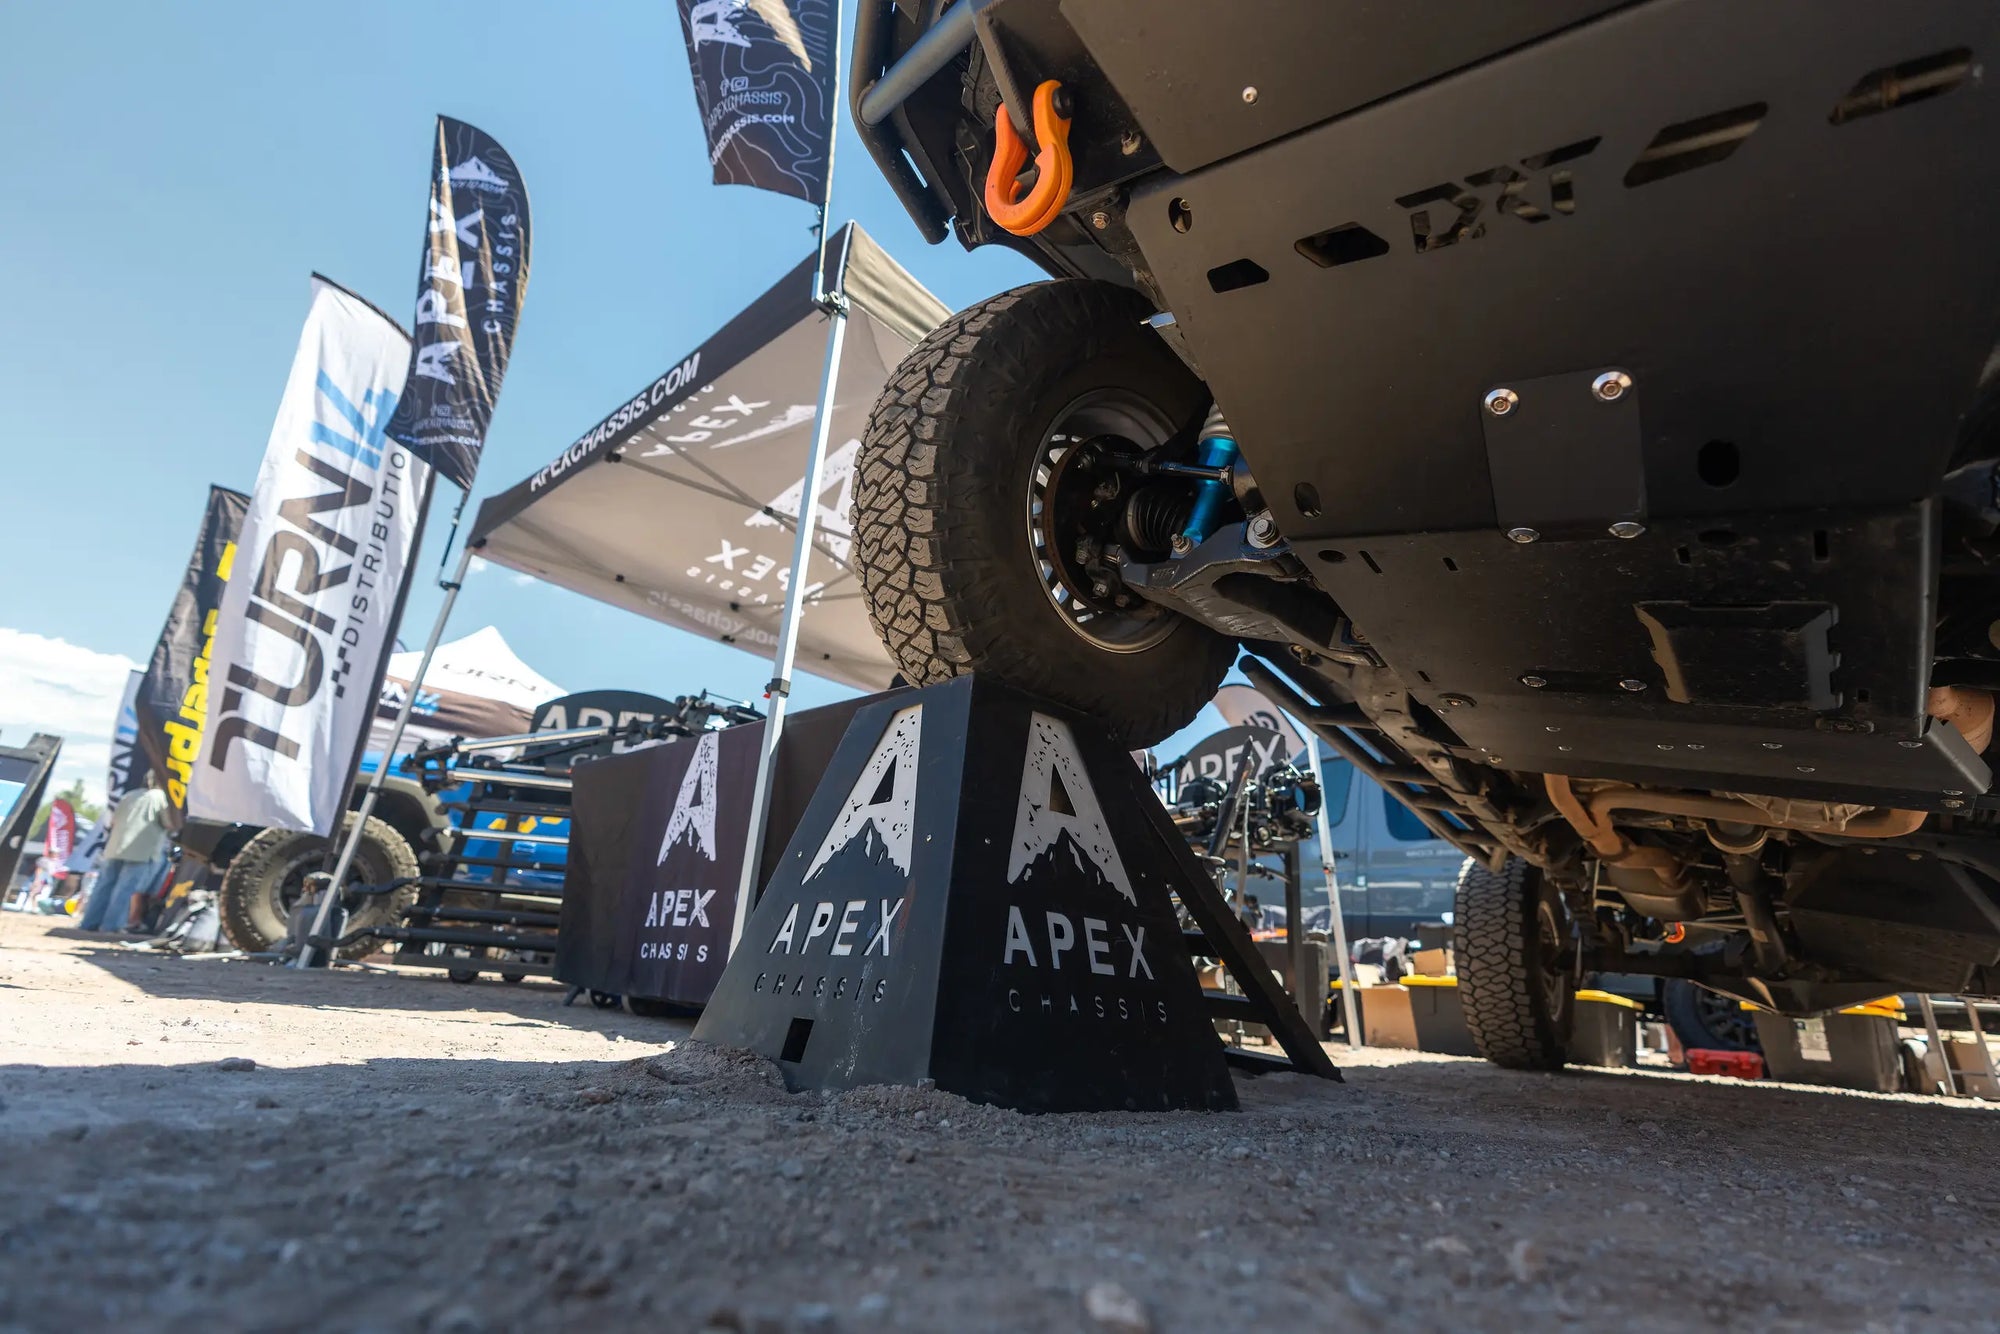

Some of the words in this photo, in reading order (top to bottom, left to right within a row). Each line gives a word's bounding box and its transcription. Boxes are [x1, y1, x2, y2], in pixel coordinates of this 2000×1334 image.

[416, 197, 484, 386] APEX
[484, 212, 516, 334] CHASSIS
[341, 451, 406, 647] DISTRIBUTIO
[528, 704, 662, 754] APE
[645, 888, 717, 928] APEX
[767, 897, 905, 956] APEX
[1003, 904, 1155, 981] APEX
[754, 972, 887, 1003] CHASSIS
[1008, 988, 1167, 1024] CHASSIS
